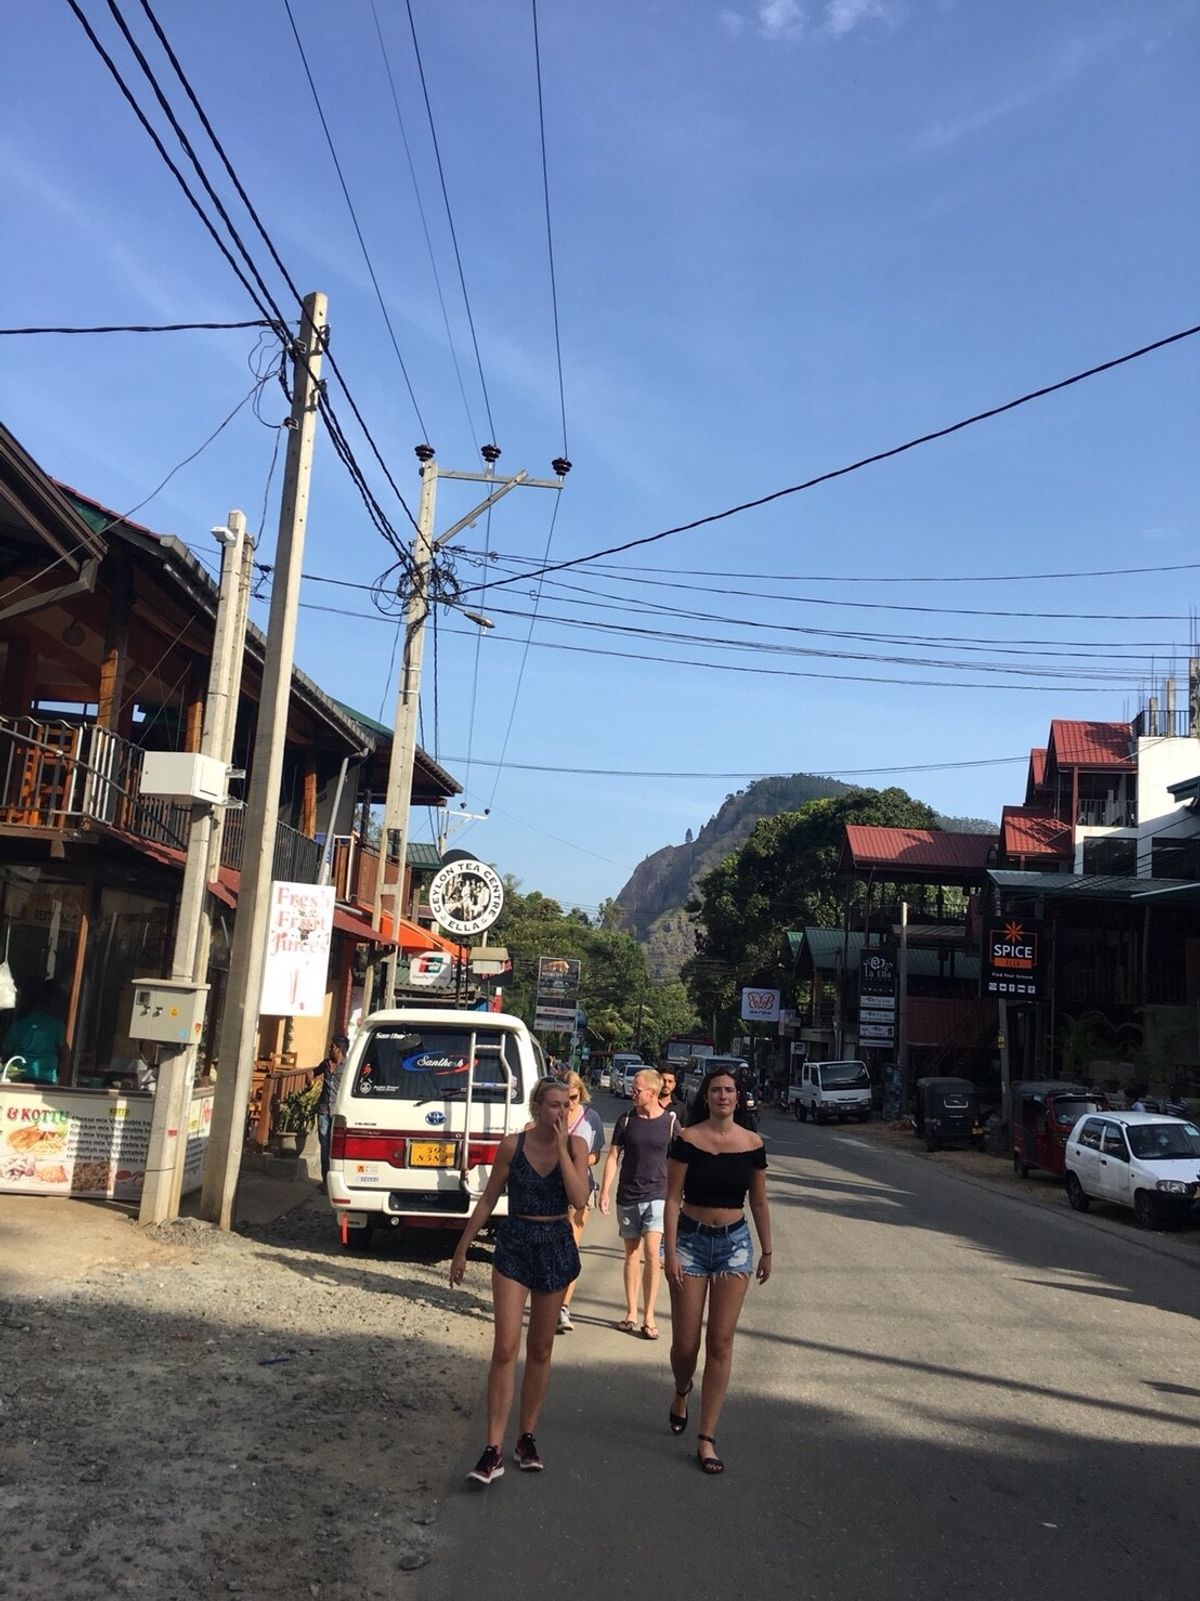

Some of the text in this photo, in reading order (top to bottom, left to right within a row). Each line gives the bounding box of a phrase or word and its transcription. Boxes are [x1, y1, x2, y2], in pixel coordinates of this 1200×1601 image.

[276, 886, 331, 908] Fresh
[432, 863, 501, 917] CEYLON TEA CENTRE
[447, 920, 480, 932] ELLA
[993, 944, 1033, 958] SPICE
[20, 1107, 69, 1126] KOTTU
